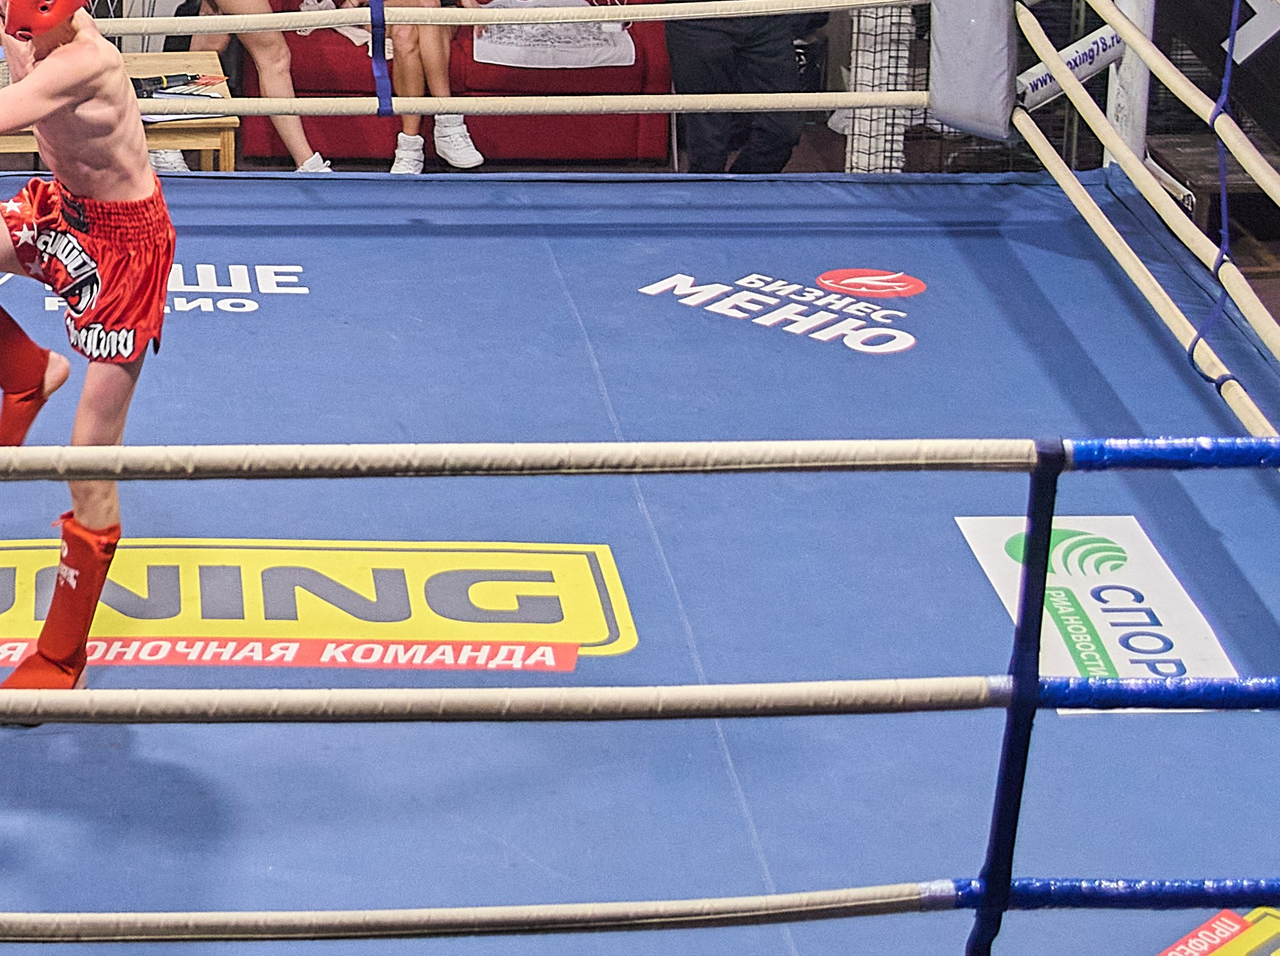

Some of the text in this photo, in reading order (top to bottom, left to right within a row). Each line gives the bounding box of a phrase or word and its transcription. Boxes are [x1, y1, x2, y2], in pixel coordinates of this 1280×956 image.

[638, 273, 917, 353] МЕНЮ
[734, 273, 907, 323] БИЗНЕС
[86, 640, 299, 662] ОНОЧНАЯ
[320, 642, 556, 668] КОМАНДА
[1045, 589, 1109, 678] РИА НОВОСТИ
[1089, 584, 1187, 679] СПОР
